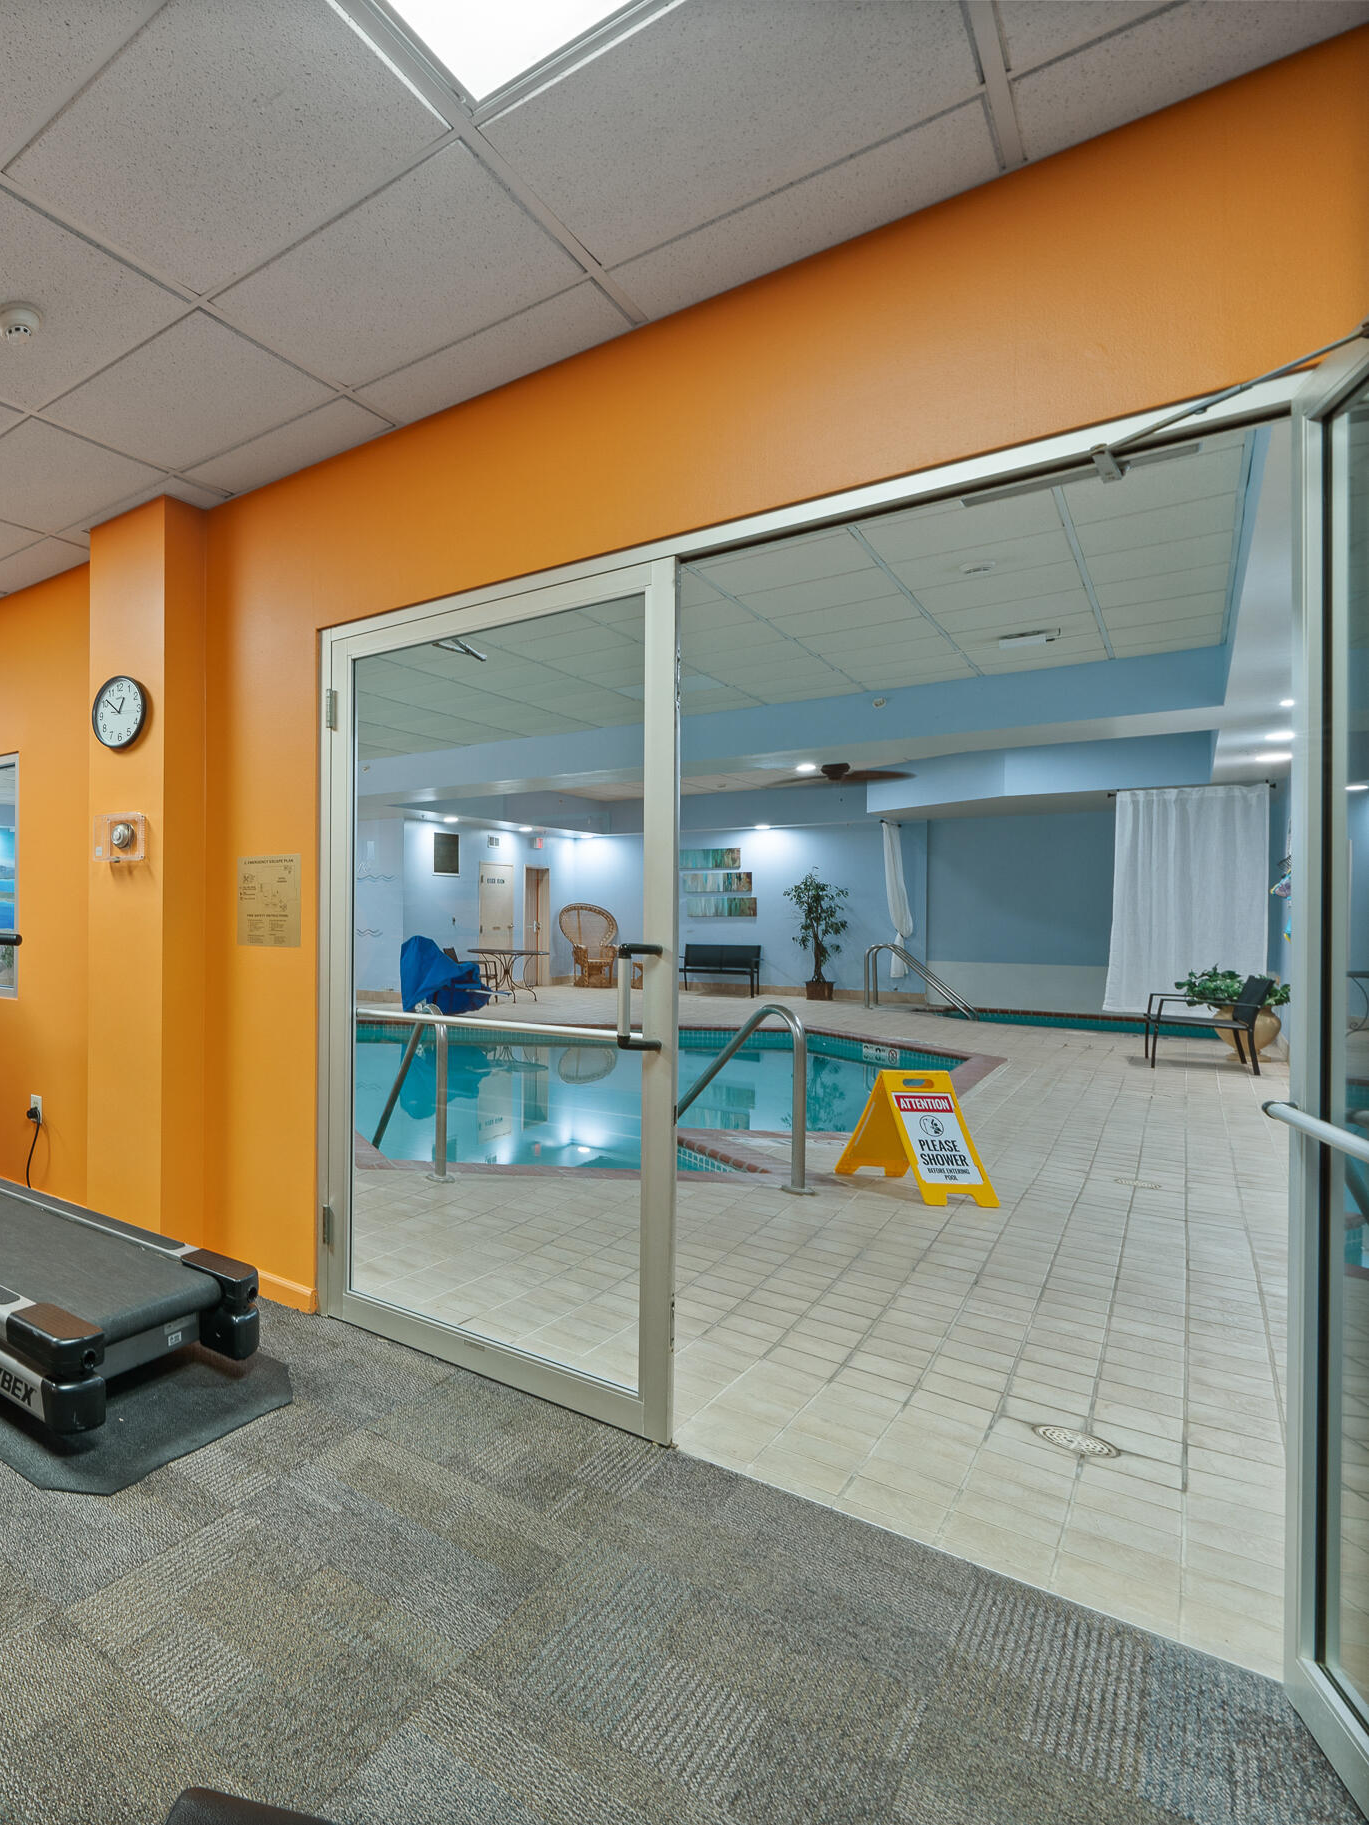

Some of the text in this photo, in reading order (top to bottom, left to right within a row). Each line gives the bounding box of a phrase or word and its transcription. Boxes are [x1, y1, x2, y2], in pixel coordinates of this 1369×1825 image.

[117, 682, 123, 692] 12
[128, 684, 131, 693] 1
[109, 688, 114, 697] 11
[134, 692, 138, 700] 2
[102, 700, 108, 708] 10
[137, 704, 141, 713] 3
[100, 712, 103, 720] 9
[102, 724, 107, 733] 8
[127, 728, 131, 736] 5
[109, 731, 113, 740] 7
[118, 733, 122, 742] 6
[899, 1097, 950, 1111] ATTENTION
[918, 1139, 960, 1153] PLEASE
[920, 1153, 969, 1167] SHOWER
